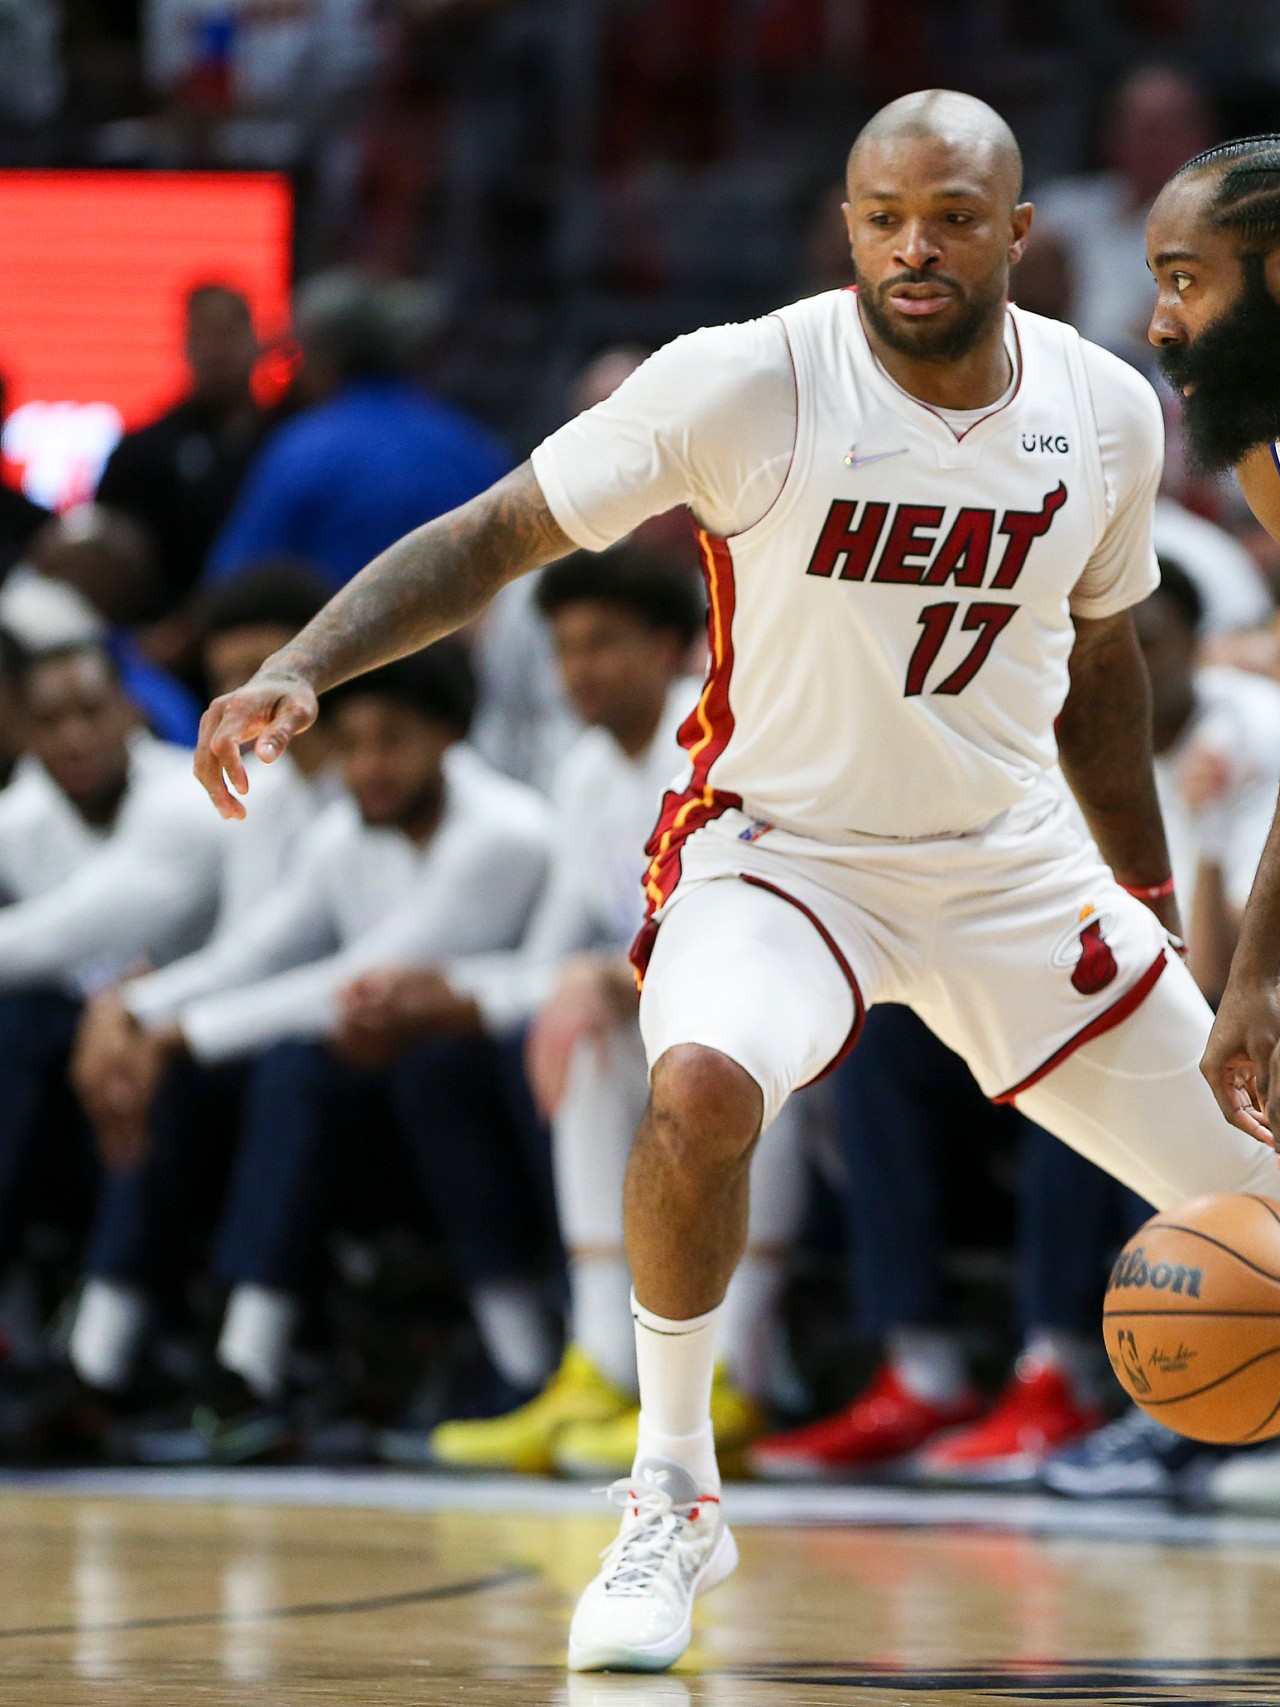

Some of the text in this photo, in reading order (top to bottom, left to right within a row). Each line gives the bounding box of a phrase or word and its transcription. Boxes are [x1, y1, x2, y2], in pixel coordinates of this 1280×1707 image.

[805, 479, 1068, 590] HEAT
[904, 601, 1021, 698] 17
[1106, 1247, 1204, 1300] ilson
